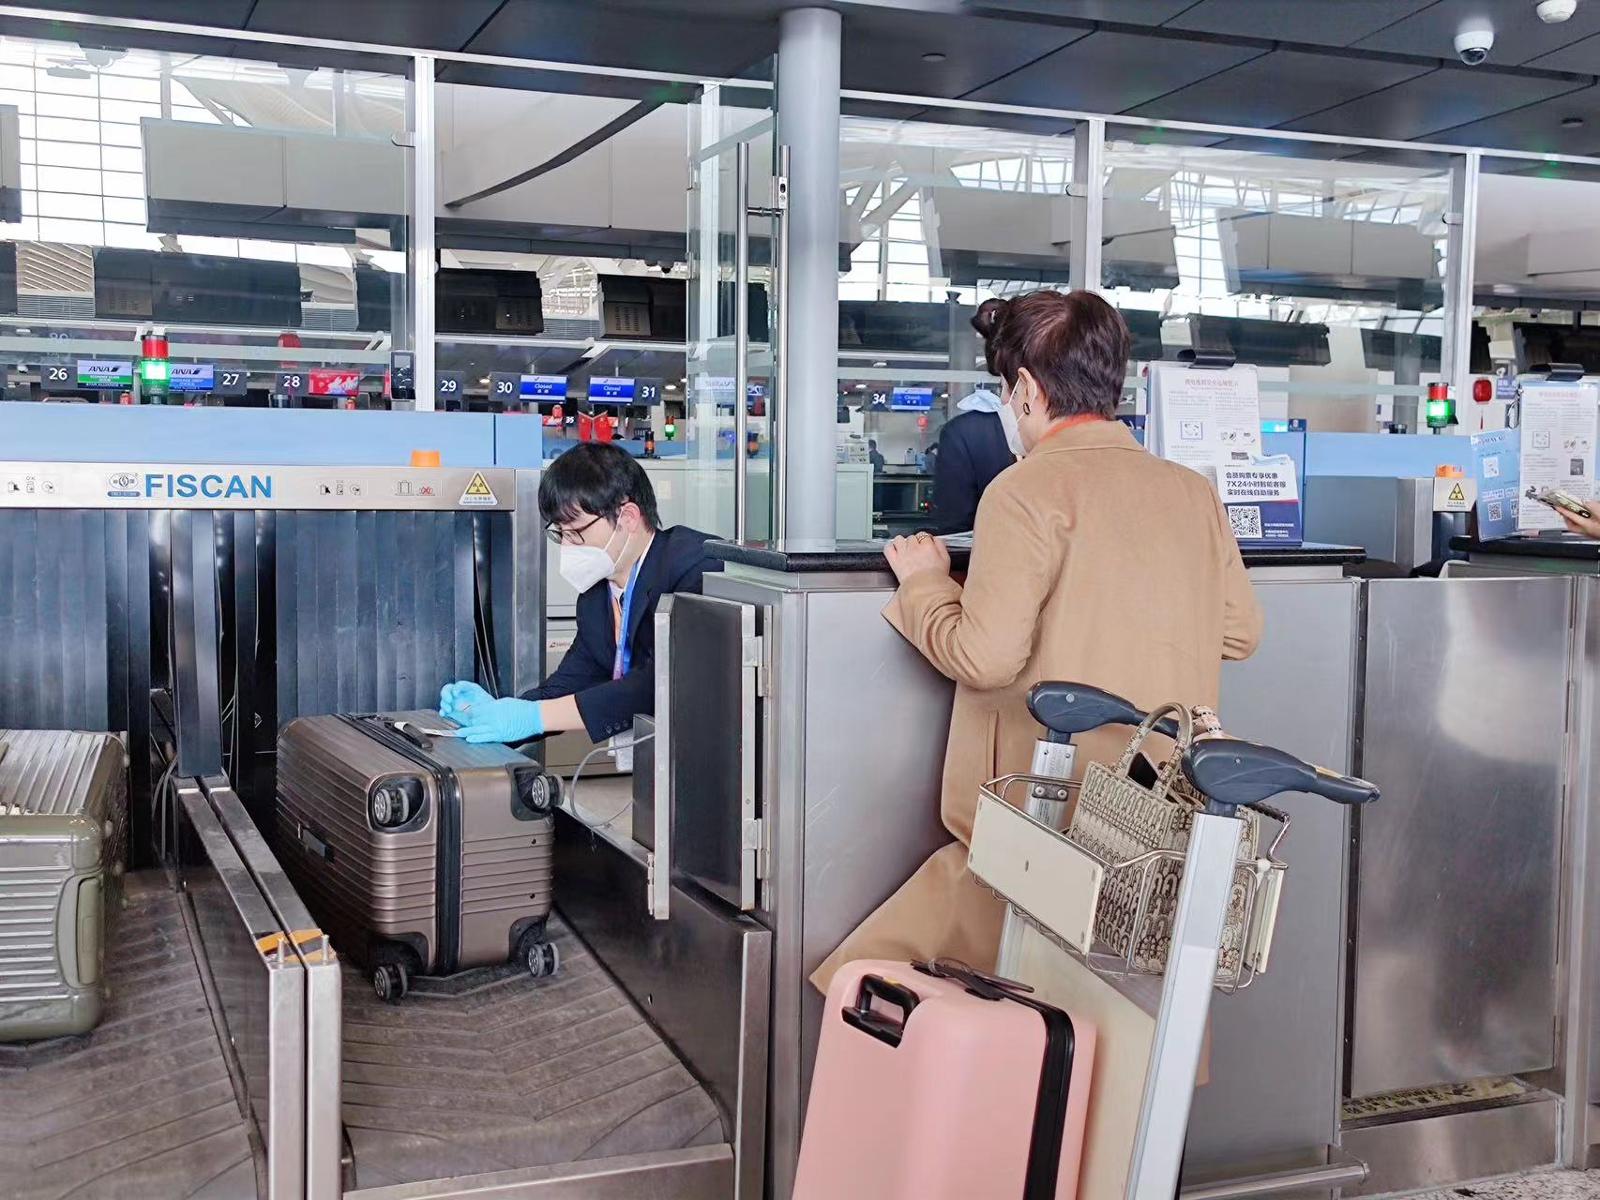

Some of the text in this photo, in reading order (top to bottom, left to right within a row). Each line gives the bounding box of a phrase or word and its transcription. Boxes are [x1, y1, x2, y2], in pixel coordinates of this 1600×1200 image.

[49, 367, 68, 381] 26
[222, 373, 240, 385] 27
[283, 375, 301, 388] 28
[440, 380, 457, 392] 29
[497, 381, 513, 394] 30
[641, 386, 656, 398] 31
[872, 393, 886, 405] 34
[145, 474, 272, 498] FISCAN
